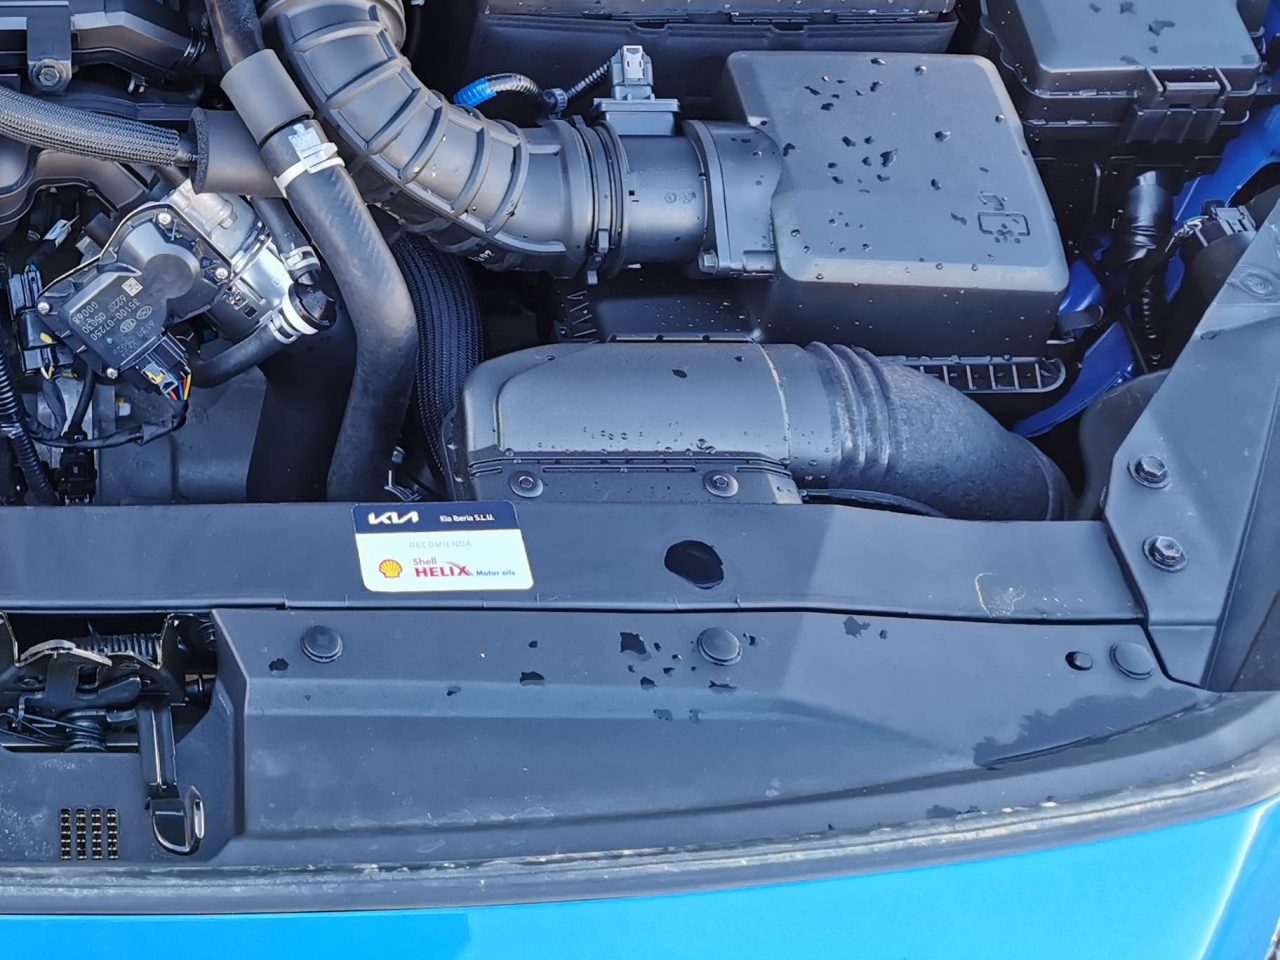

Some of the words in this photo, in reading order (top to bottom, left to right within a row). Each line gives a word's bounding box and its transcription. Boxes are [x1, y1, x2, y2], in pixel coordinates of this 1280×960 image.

[367, 510, 421, 525] KIA
[439, 515, 453, 523] Kia
[453, 514, 474, 522] Iberia
[474, 513, 496, 522] S.L.U.
[409, 539, 472, 549] RECOMIENDA
[413, 557, 437, 566] Shell
[414, 566, 472, 578] HELIX
